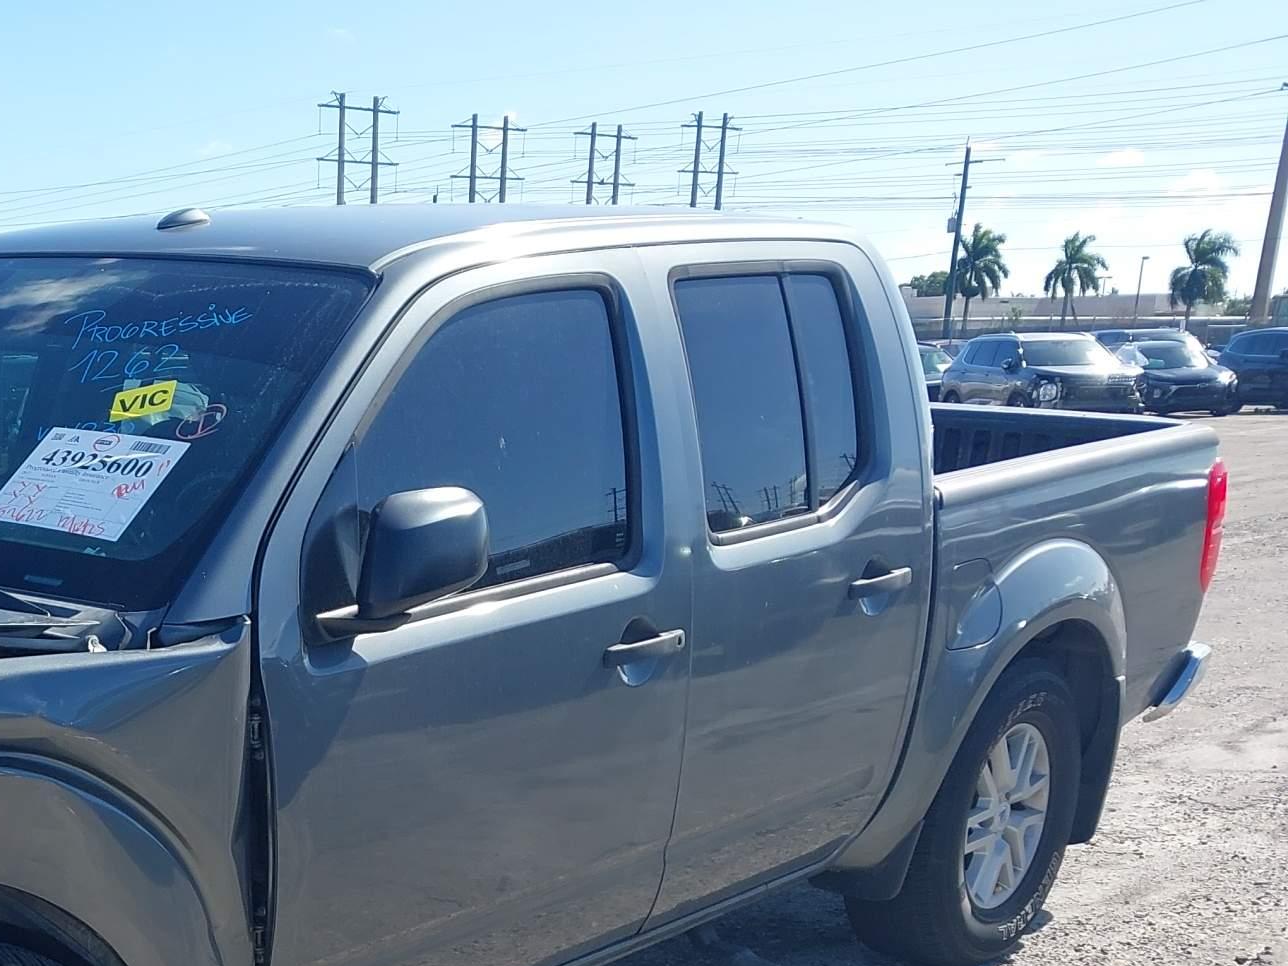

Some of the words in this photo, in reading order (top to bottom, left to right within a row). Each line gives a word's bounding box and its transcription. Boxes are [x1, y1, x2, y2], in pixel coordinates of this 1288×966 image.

[68, 344, 189, 383] 1262
[118, 389, 170, 413] VIC
[41, 448, 154, 478] 43925600
